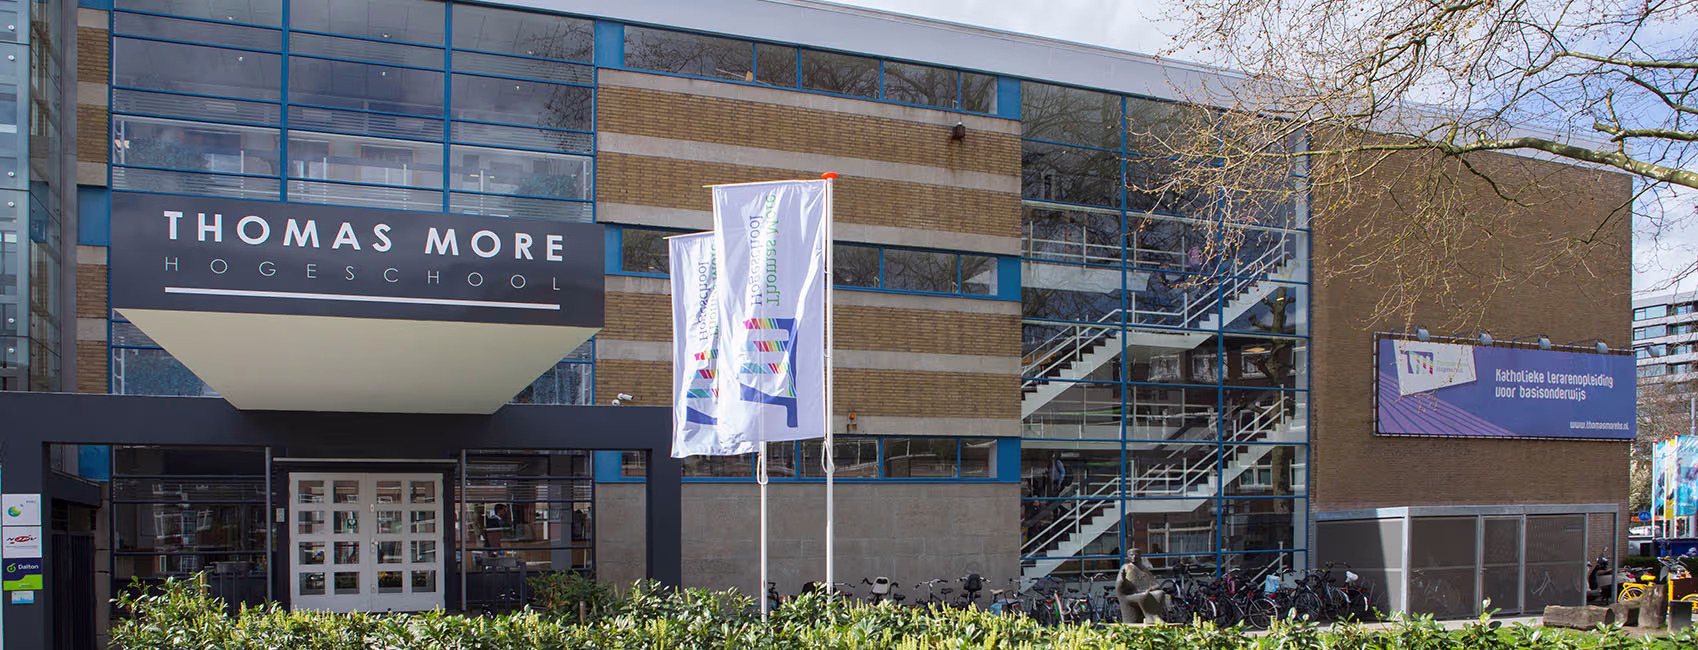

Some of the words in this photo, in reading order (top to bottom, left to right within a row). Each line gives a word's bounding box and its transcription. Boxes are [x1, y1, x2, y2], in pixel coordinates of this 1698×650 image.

[164, 211, 392, 252] THOMAS
[424, 227, 563, 262] MORE
[165, 256, 560, 291] HOGESCHOOL
[1495, 368, 1545, 384] Katholieke
[1547, 371, 1614, 389] lerarenopleiding
[1495, 386, 1516, 399] voor
[1519, 386, 1587, 402] basisonderwijs
